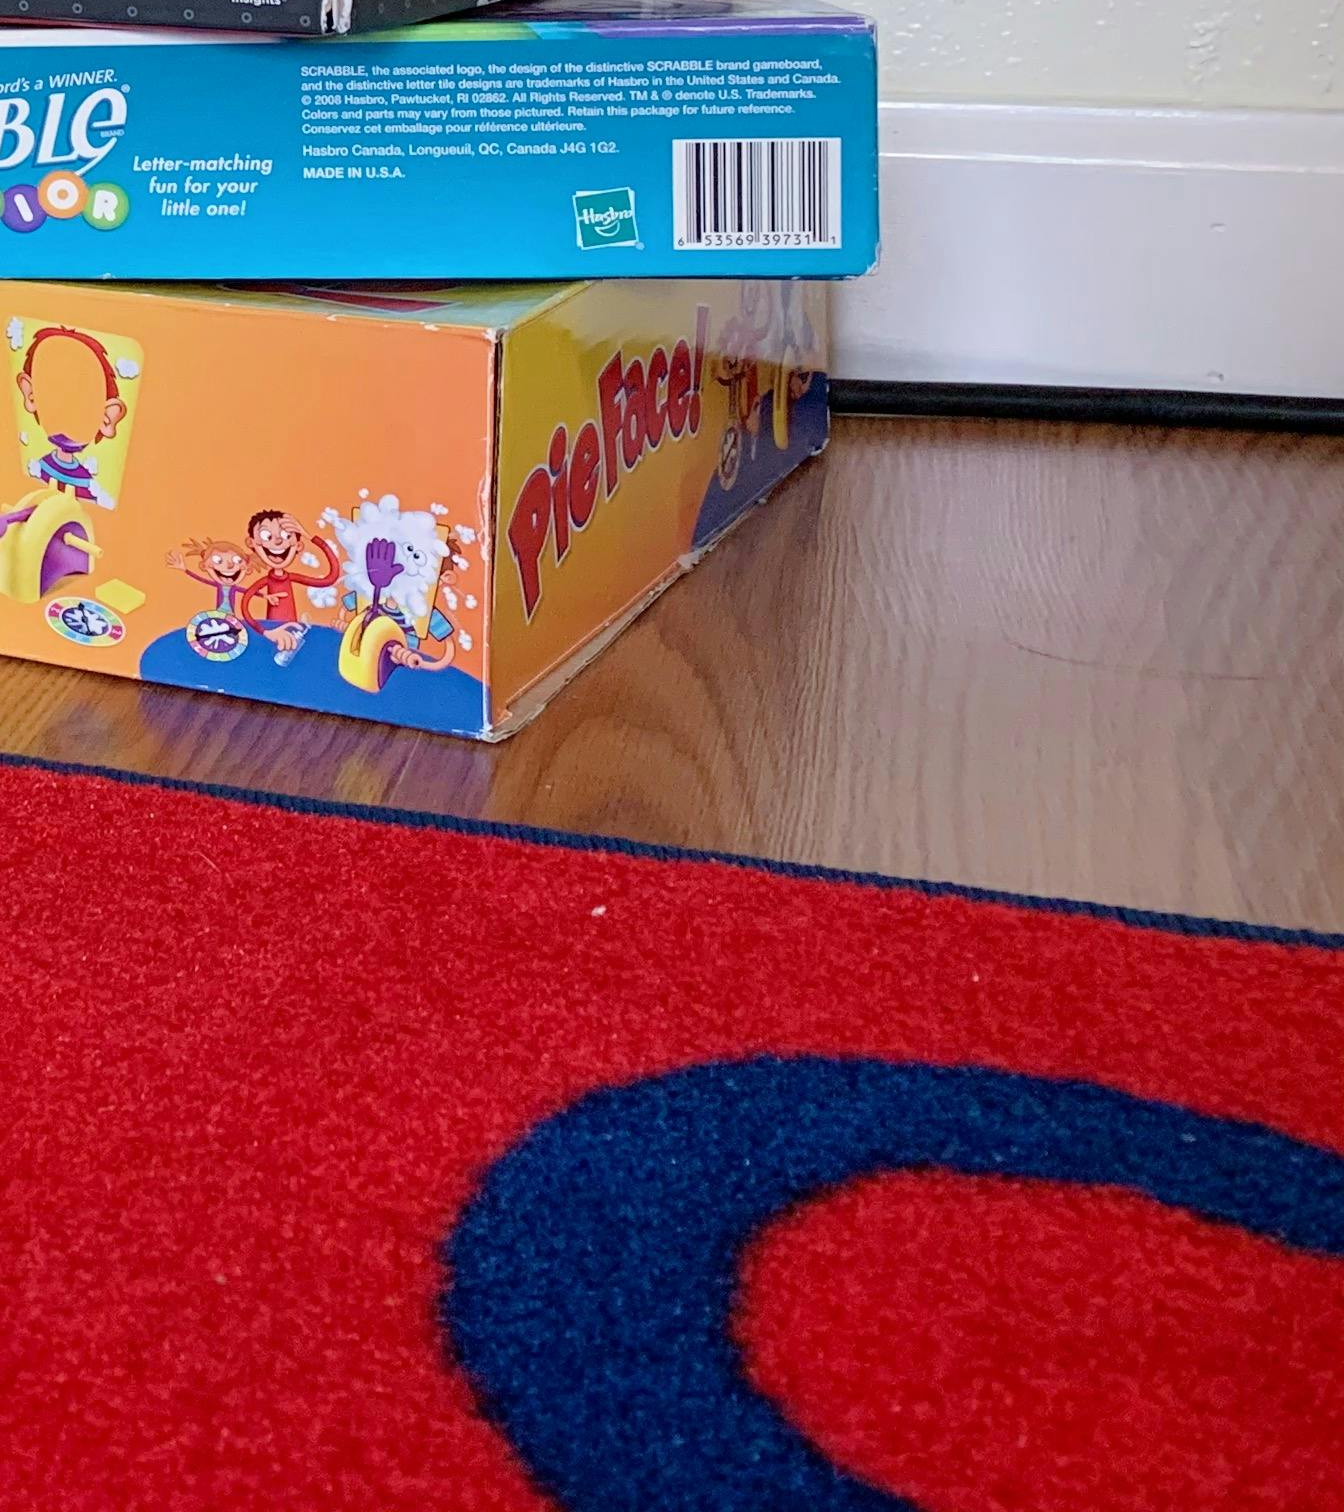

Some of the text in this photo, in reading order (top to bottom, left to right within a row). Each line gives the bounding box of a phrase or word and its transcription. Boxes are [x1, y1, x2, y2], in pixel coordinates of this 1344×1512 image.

[300, 59, 823, 78] SCRABBLE, the associated logo, the design of the distinctive SCRABBLE brand gameboard,
[33, 79, 44, 92] a
[48, 69, 118, 90] WINNER.
[301, 73, 842, 92] and the distinctive letter tile designs are trademarks of Hasbro in the United States and Canada.
[344, 94, 389, 106] Hasbro,
[390, 93, 454, 106] Pawtucket,
[456, 92, 469, 104] RI
[512, 92, 527, 103] All
[529, 92, 566, 105] Rights
[569, 91, 626, 102] Reserved.
[629, 90, 648, 101] TM
[650, 90, 659, 101] &
[675, 89, 716, 101] denote
[718, 89, 742, 100] U.S.
[745, 88, 817, 100] Trademarks.
[301, 103, 795, 121] Colors and parts may vary from those pictured. Retain this package for future reference.
[302, 123, 361, 135] Conservez
[363, 123, 382, 134] cet
[384, 122, 443, 135] emballage
[445, 124, 471, 135] pour
[302, 141, 620, 159] Hasbro Canada, Longueuil, QC, Canada J4G 1G2.
[133, 153, 273, 175] Letter-matching
[302, 166, 406, 179] MADE IN U.S.A.
[149, 176, 259, 198] fun for your
[161, 198, 246, 216] little one!
[577, 206, 633, 226] Hasbro
[677, 236, 686, 247] 6
[704, 234, 755, 247] 53569
[763, 233, 812, 246] 39731
